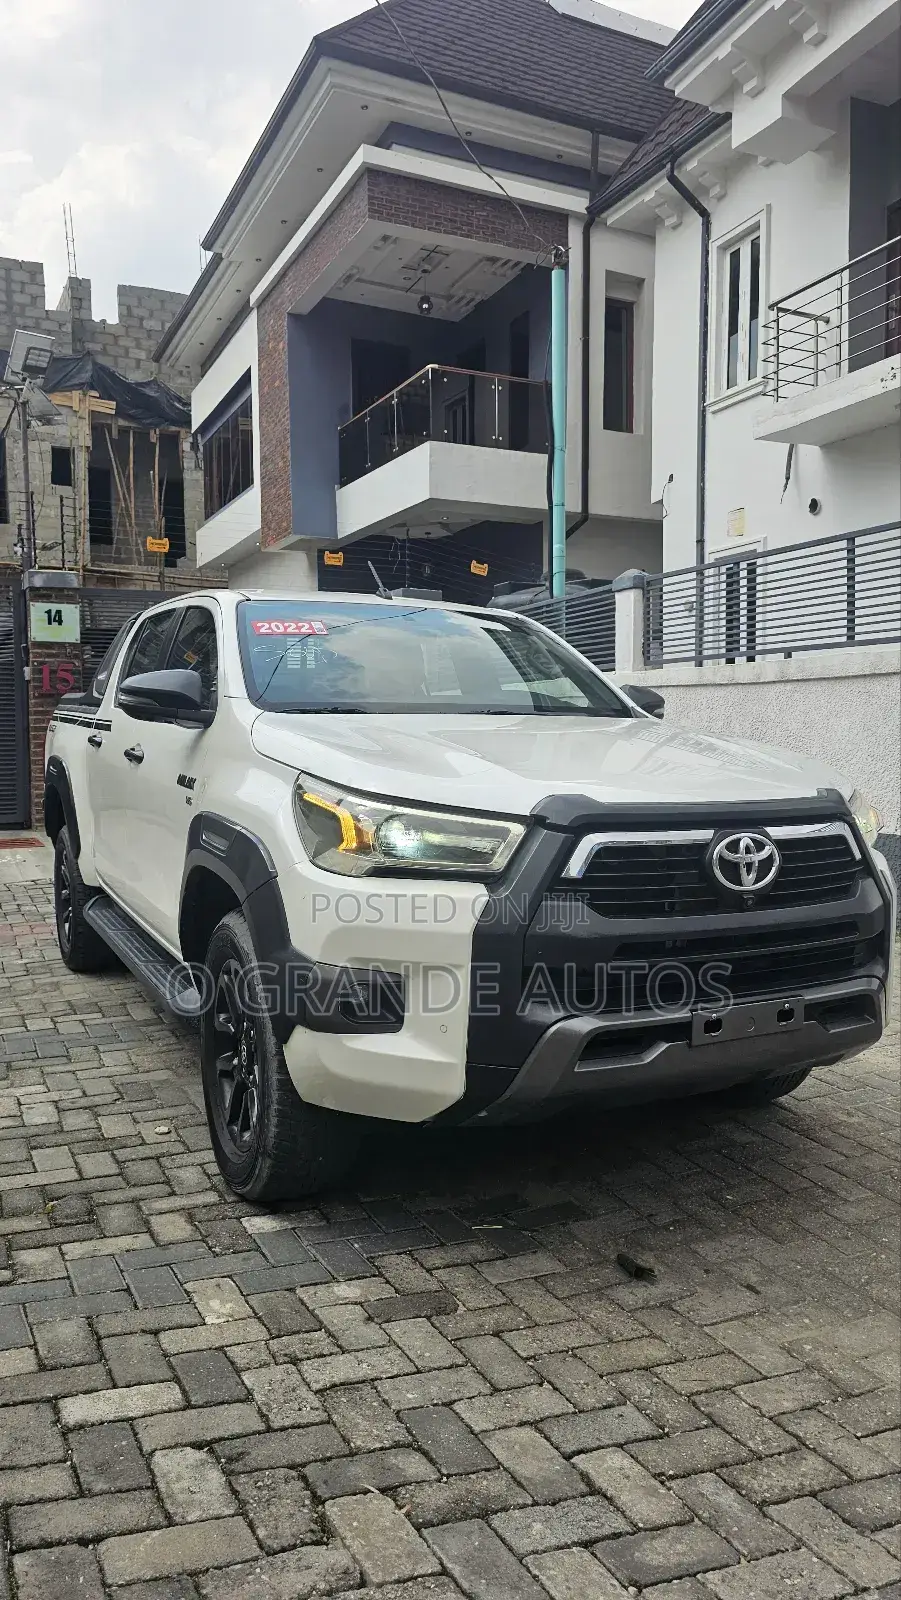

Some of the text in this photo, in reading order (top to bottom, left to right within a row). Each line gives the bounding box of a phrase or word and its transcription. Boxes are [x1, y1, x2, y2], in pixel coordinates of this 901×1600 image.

[44, 609, 64, 626] 14
[256, 622, 313, 633] 2022
[42, 664, 76, 693] 15
